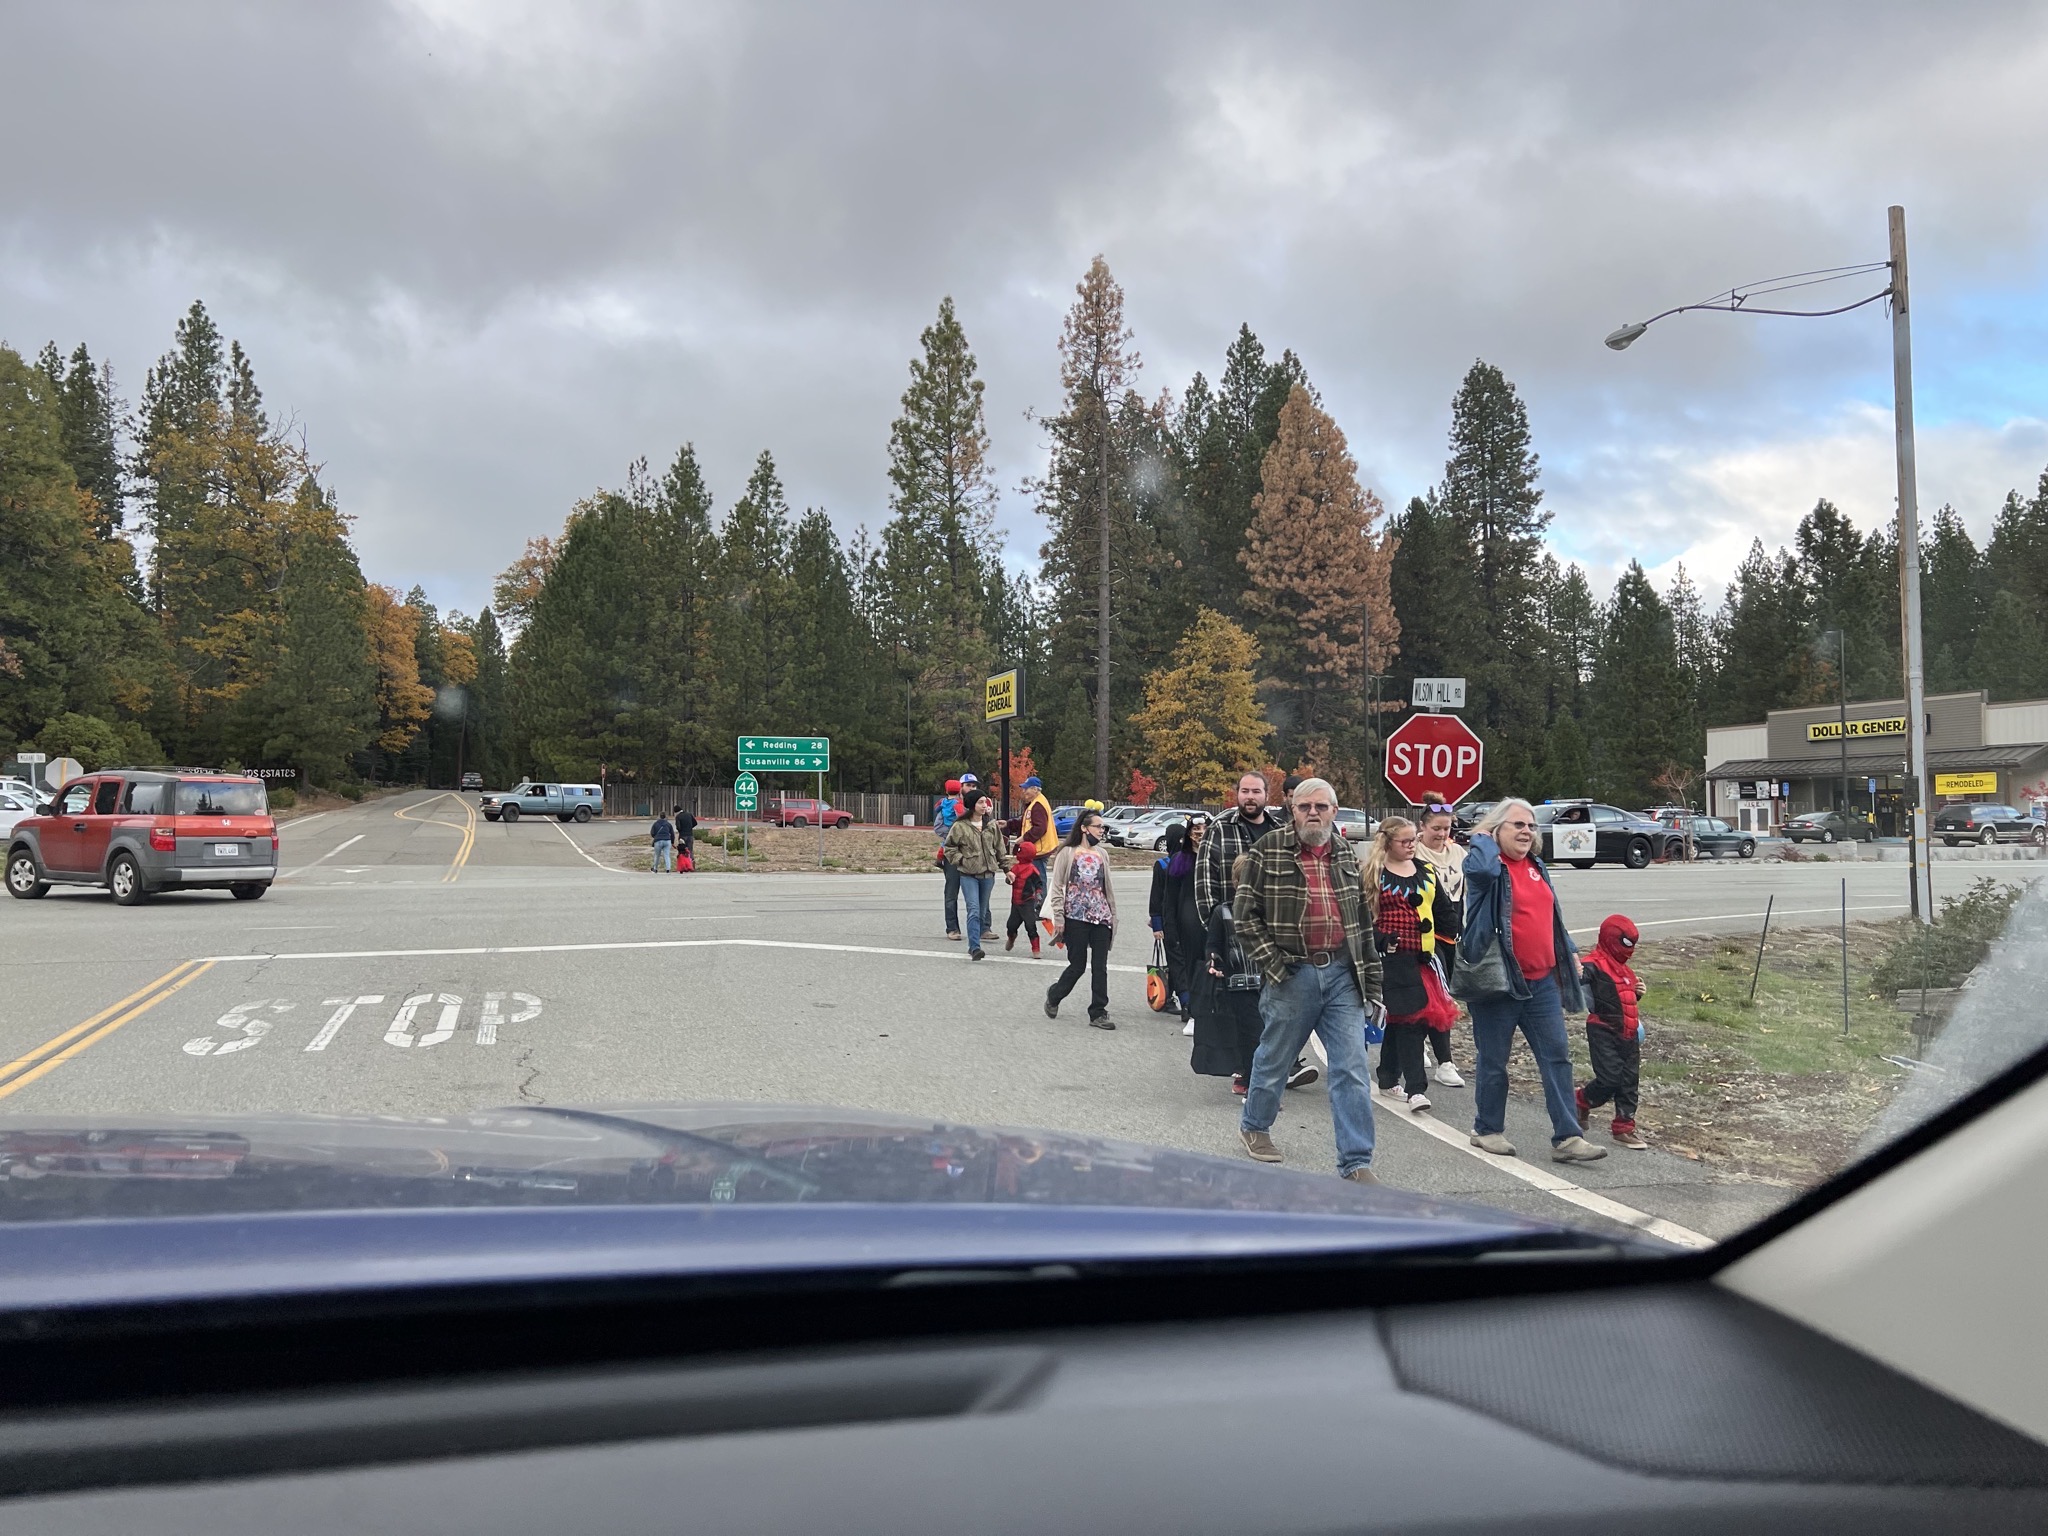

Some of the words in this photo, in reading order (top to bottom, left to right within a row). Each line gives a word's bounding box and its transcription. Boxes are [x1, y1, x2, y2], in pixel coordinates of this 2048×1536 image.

[989, 681, 1011, 698] DOLLAR
[1414, 683, 1433, 702] WILSON
[1437, 683, 1451, 703] HILL
[987, 696, 1012, 713] GENERAL
[1861, 720, 1906, 734] GENERA
[763, 741, 797, 751] Redding
[811, 742, 823, 750] 28
[745, 758, 790, 766] Susanville
[794, 758, 806, 766] 86
[1392, 742, 1477, 779] STOP
[260, 769, 296, 778] ESTATES
[738, 781, 755, 793] 44
[1946, 779, 1984, 788] REMODELED
[182, 991, 543, 1055] STOP
